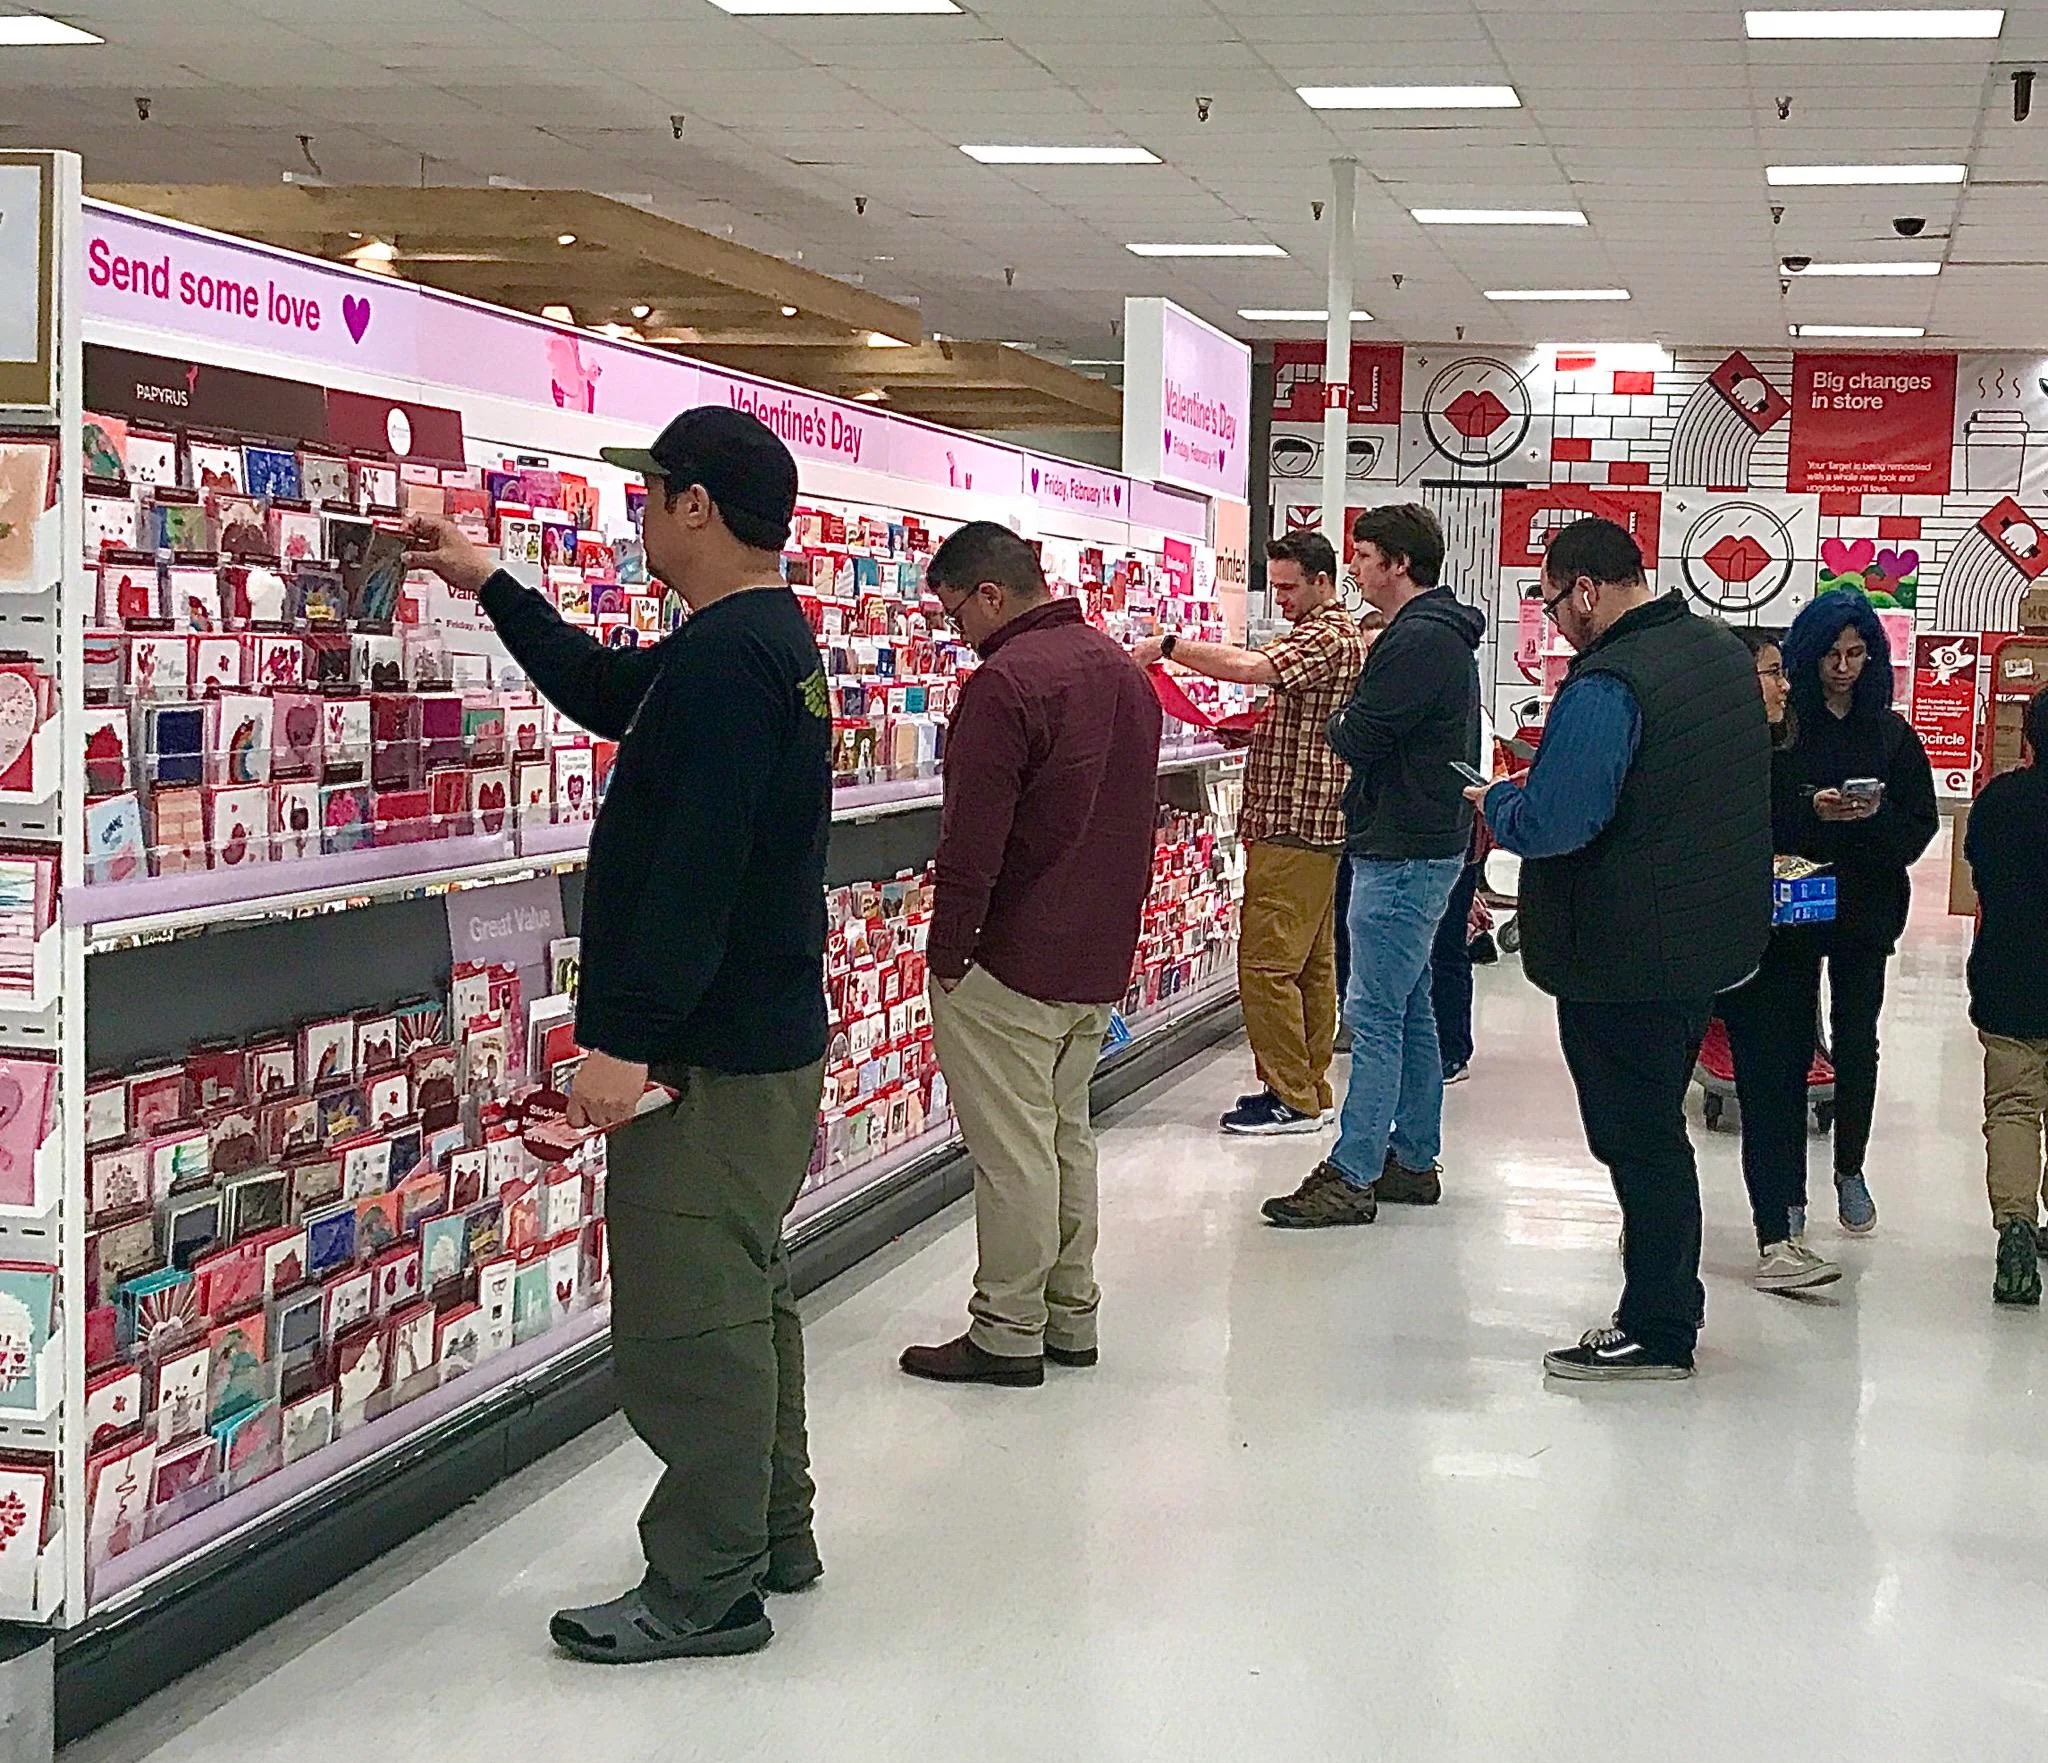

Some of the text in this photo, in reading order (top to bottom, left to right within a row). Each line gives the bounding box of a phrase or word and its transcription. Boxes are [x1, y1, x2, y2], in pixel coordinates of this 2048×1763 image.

[88, 238, 321, 331] Send some love
[1813, 371, 1932, 393] Big changes
[135, 383, 190, 407] PAPYRUS
[1811, 391, 1884, 410] in store
[831, 411, 863, 464] Day
[1219, 402, 1237, 449] Day
[1807, 461, 1826, 470] Your
[1807, 472, 1825, 481] with
[1833, 473, 1859, 482] whole
[1859, 474, 1878, 482] new
[1879, 473, 1897, 482] look
[1898, 474, 1916, 482] and
[1044, 473, 1111, 509] Friday, February 14
[1216, 546, 1246, 584] minted
[446, 619, 476, 632] Friday,
[1927, 731, 1966, 746] circle
[469, 905, 551, 942] Great Value
